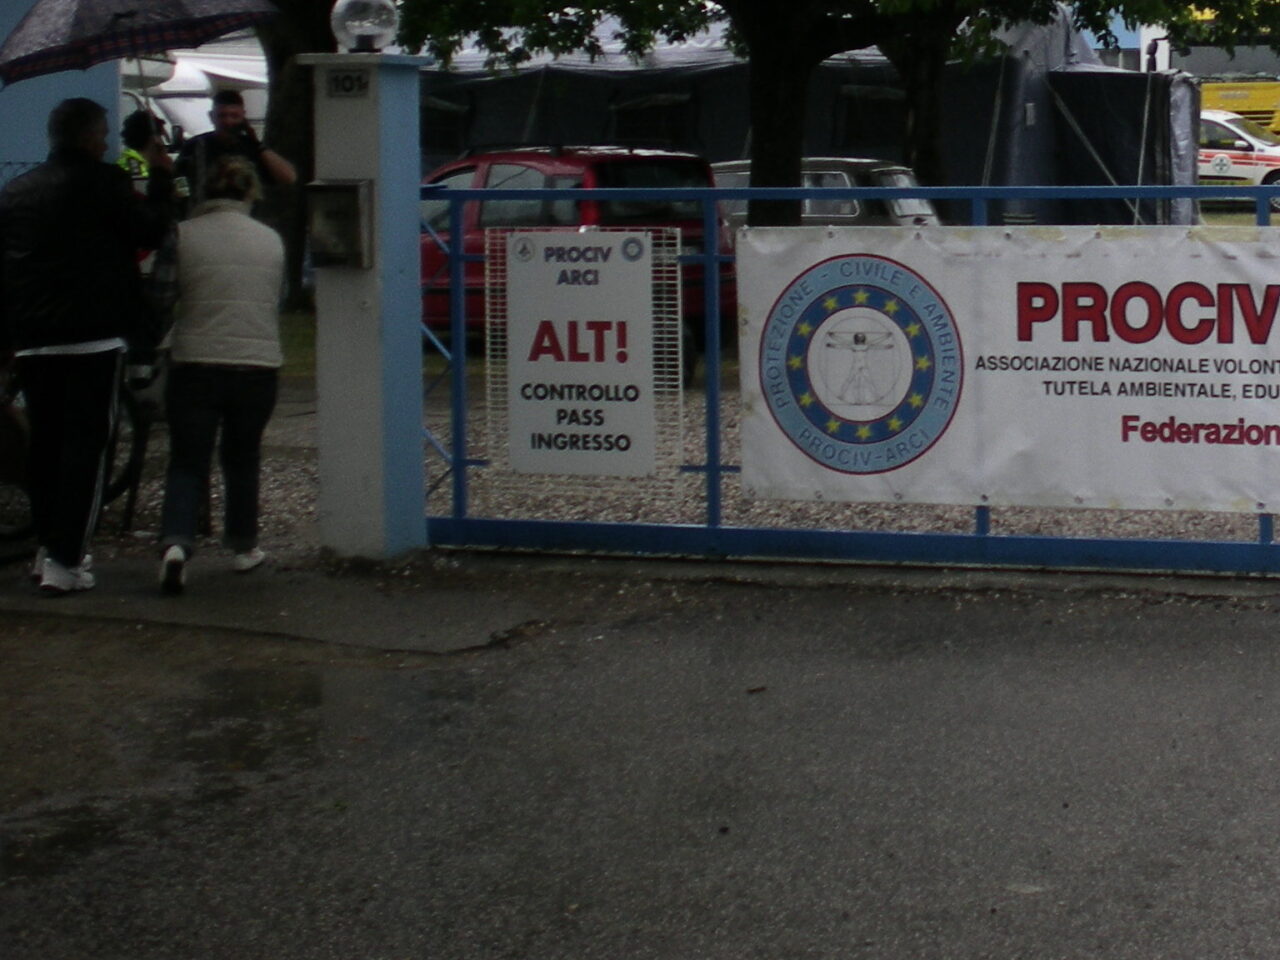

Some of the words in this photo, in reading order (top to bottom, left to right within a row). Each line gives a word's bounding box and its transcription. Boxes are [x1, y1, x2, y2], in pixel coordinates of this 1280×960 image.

[544, 246, 612, 263] PROCIV
[557, 269, 599, 286] ARCI
[528, 320, 629, 364] ALT!
[766, 279, 811, 410] PROTEZIONE
[840, 261, 903, 283] CIVILE
[924, 302, 955, 411] AMBIENTE
[975, 355, 1104, 371] ASSOCIAZIONE
[1109, 357, 1209, 374] NAZIONALE
[521, 383, 640, 402] CONTROLLO
[1043, 380, 1112, 396] TUTELA
[1117, 381, 1237, 400] AMBIENTALE,
[557, 409, 604, 426] PASS
[531, 433, 631, 452] INGRESSO
